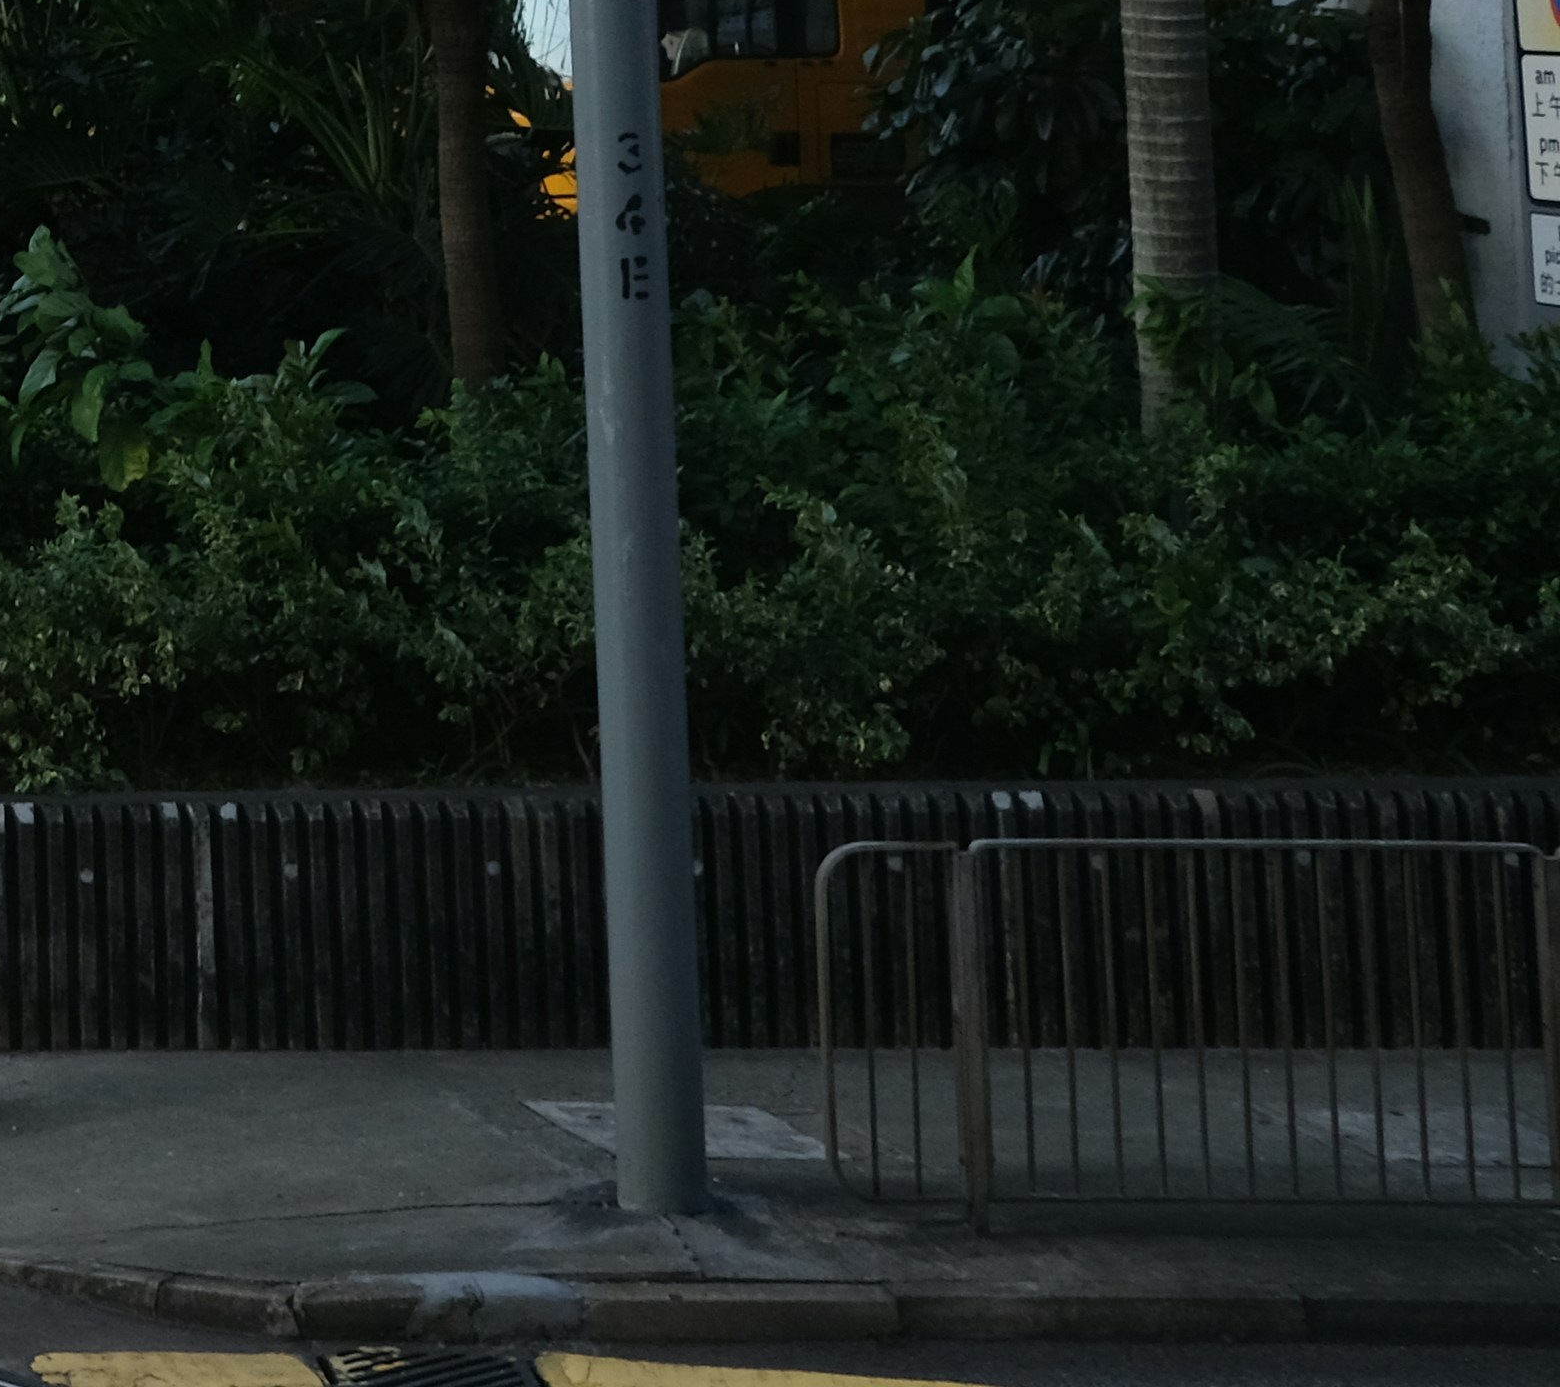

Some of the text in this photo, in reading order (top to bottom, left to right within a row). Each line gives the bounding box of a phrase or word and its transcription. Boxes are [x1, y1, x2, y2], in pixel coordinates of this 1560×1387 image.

[1535, 69, 1555, 85] am
[1539, 137, 1560, 156] pm
[1541, 271, 1560, 296] 的
